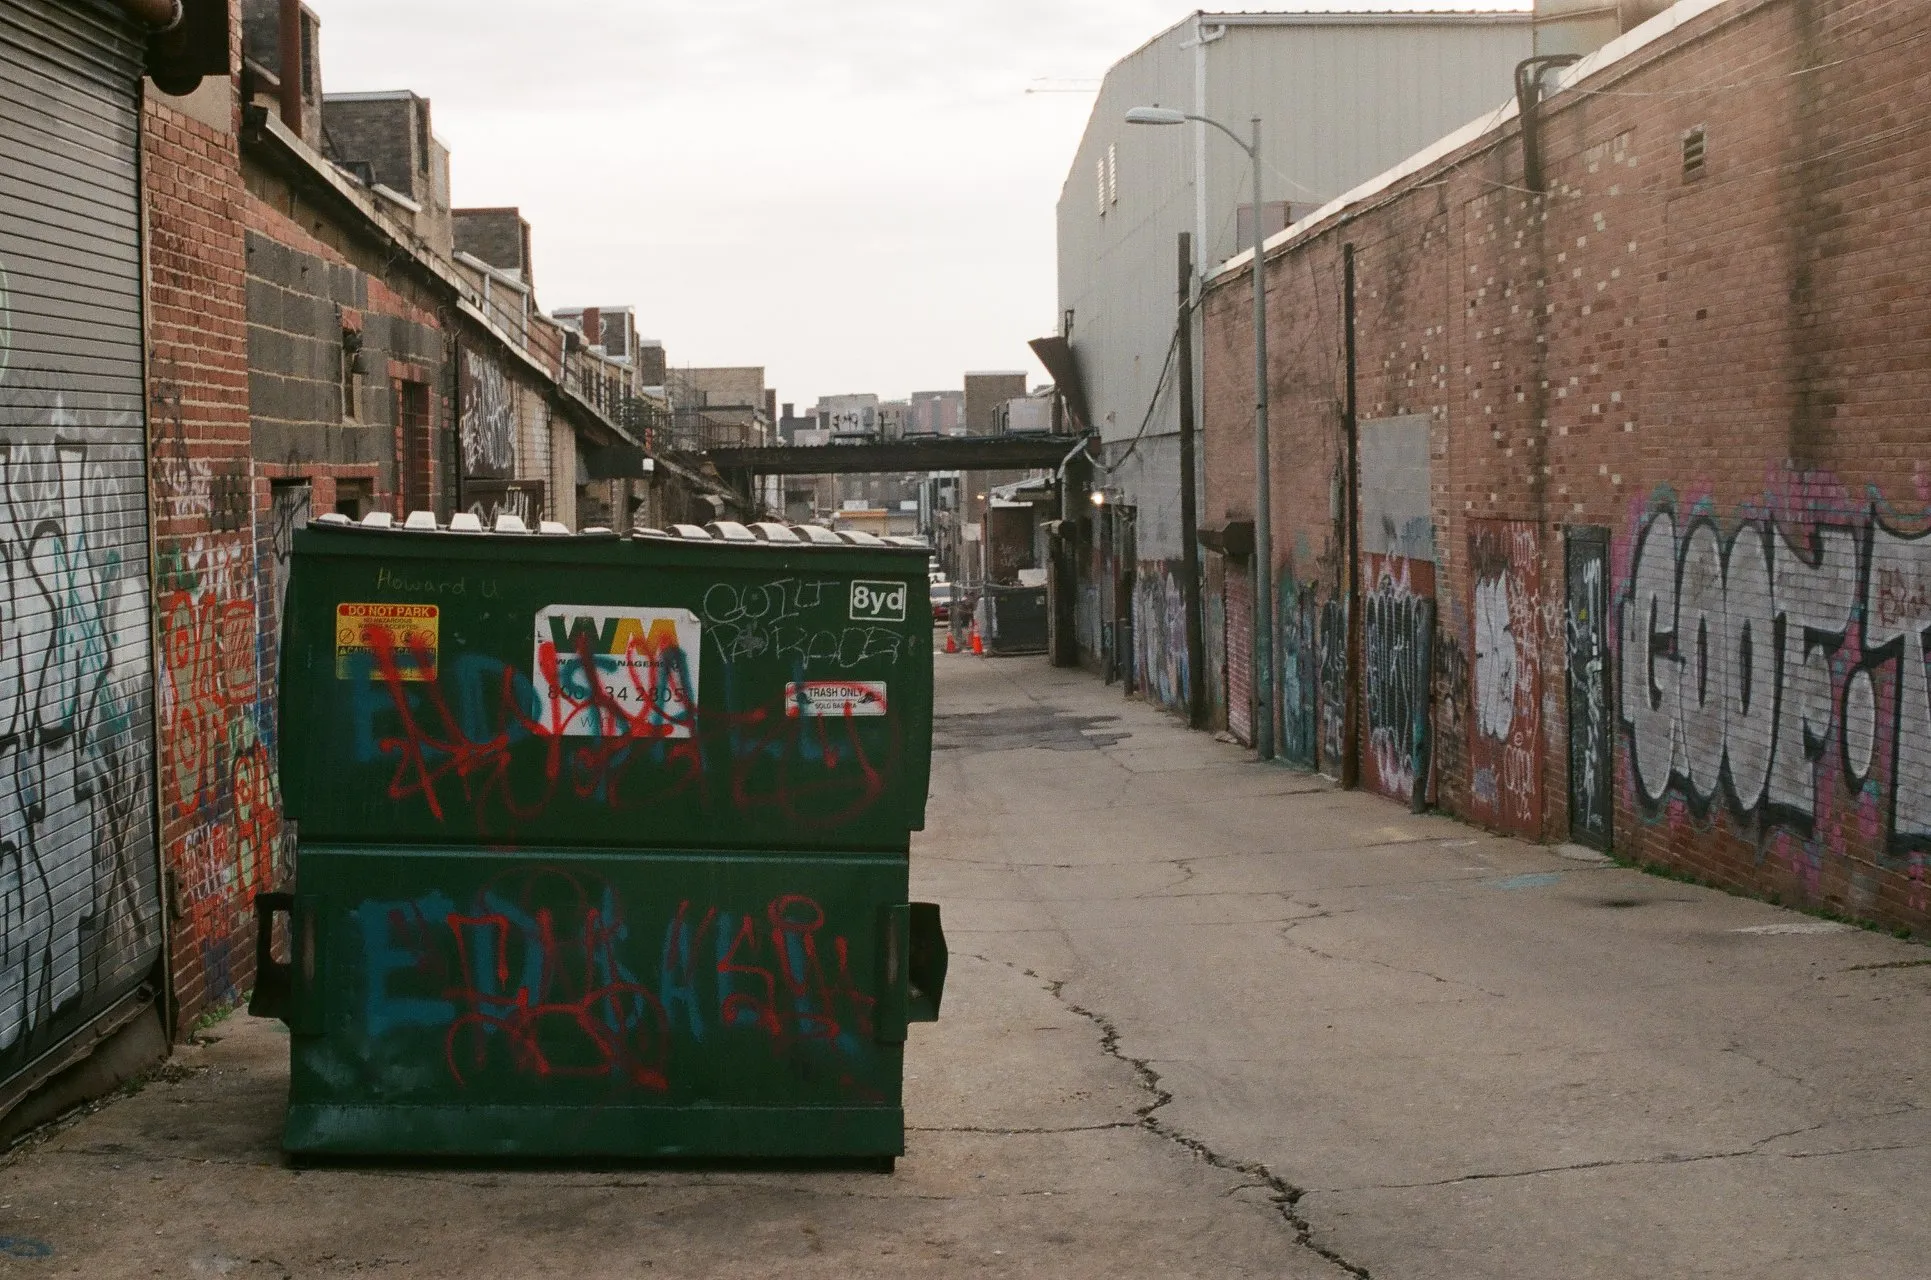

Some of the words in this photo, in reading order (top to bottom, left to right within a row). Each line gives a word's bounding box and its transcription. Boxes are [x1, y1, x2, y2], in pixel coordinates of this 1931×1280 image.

[376, 566, 466, 595] Howard
[853, 586, 904, 614] 8yd
[348, 605, 366, 616] DO
[369, 606, 394, 617] NOT
[397, 606, 430, 617] PARK
[808, 687, 838, 698] TRASH
[840, 687, 864, 698] ONLY
